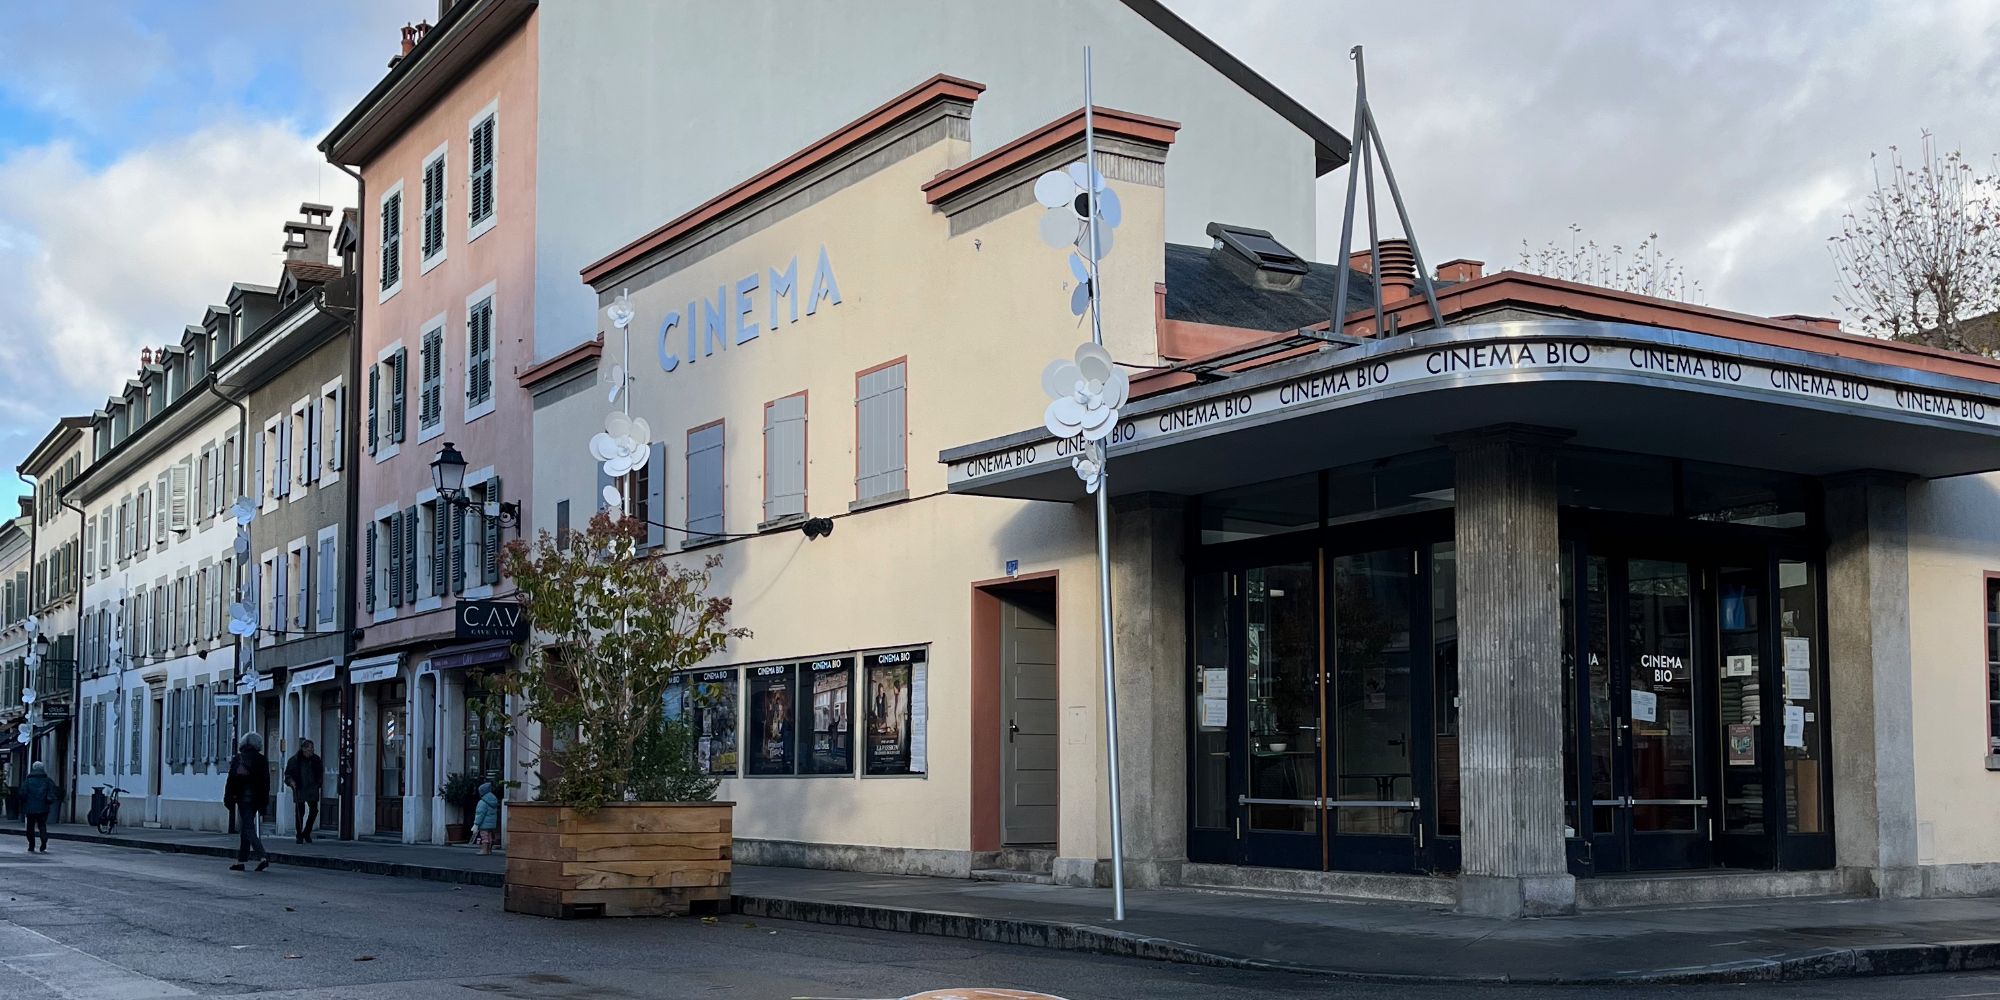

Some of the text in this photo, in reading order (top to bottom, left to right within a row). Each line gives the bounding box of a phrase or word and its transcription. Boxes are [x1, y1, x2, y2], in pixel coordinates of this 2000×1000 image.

[658, 243, 842, 372] CINEMA
[1427, 342, 1590, 374] CINEMA BIO
[1629, 346, 1741, 382] CINEMA BIO
[1280, 362, 1389, 404] CINEMA BIO
[1770, 368, 1869, 401] CINEMA BIO
[1159, 394, 1252, 432] CINEMA BIO
[1896, 390, 1985, 420] CINEMA BIO
[1056, 422, 1136, 457] CINE BIO
[967, 446, 1036, 478] CINEMA BIO
[757, 665, 784, 675] CINEMA BIO
[811, 659, 842, 670] CINEMA BIO
[879, 651, 911, 663] CINEMA BIO
[1641, 654, 1683, 668] CINEMA
[703, 671, 720, 680] CINEMA
[1654, 669, 1673, 682] BIO
